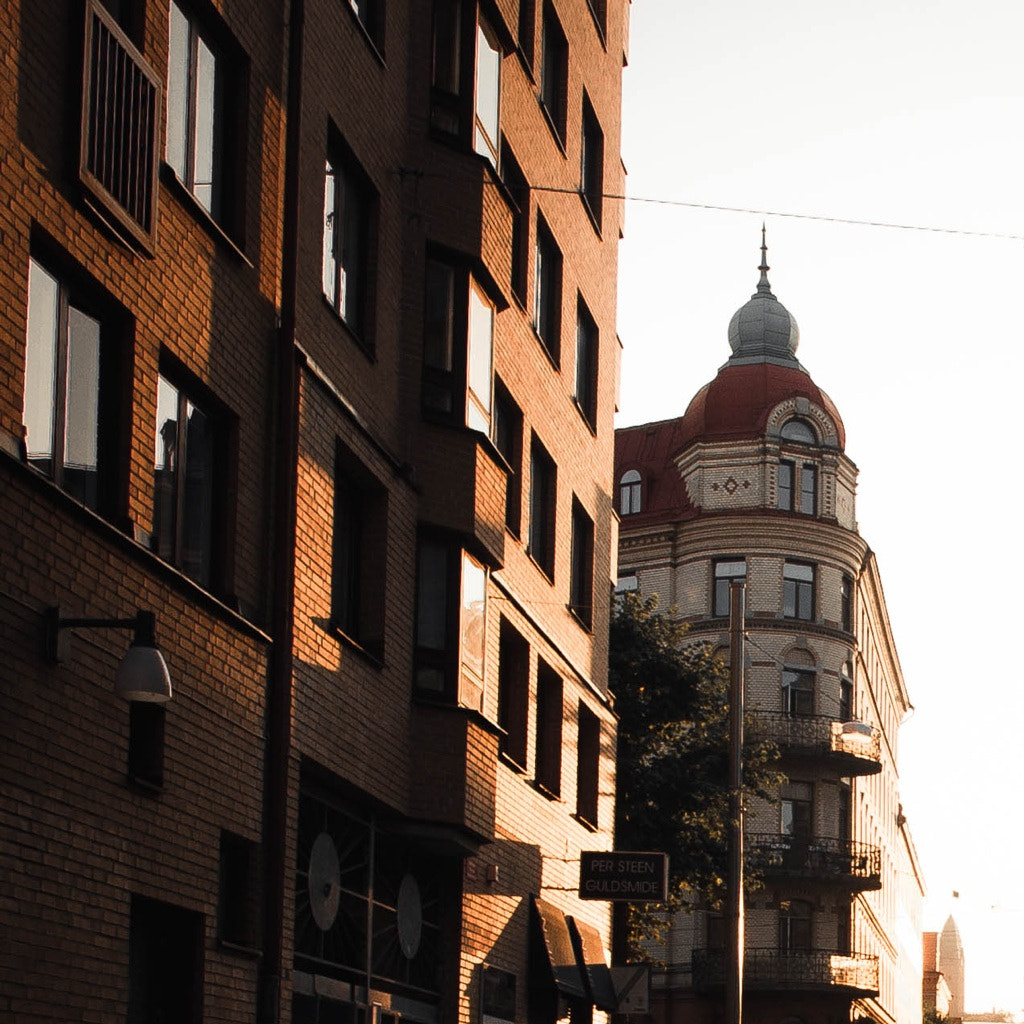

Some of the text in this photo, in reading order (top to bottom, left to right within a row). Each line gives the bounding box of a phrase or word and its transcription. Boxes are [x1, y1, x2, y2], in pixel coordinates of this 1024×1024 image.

[591, 860, 654, 873] PER STEEN
[585, 879, 657, 893] GULDSMIDE
